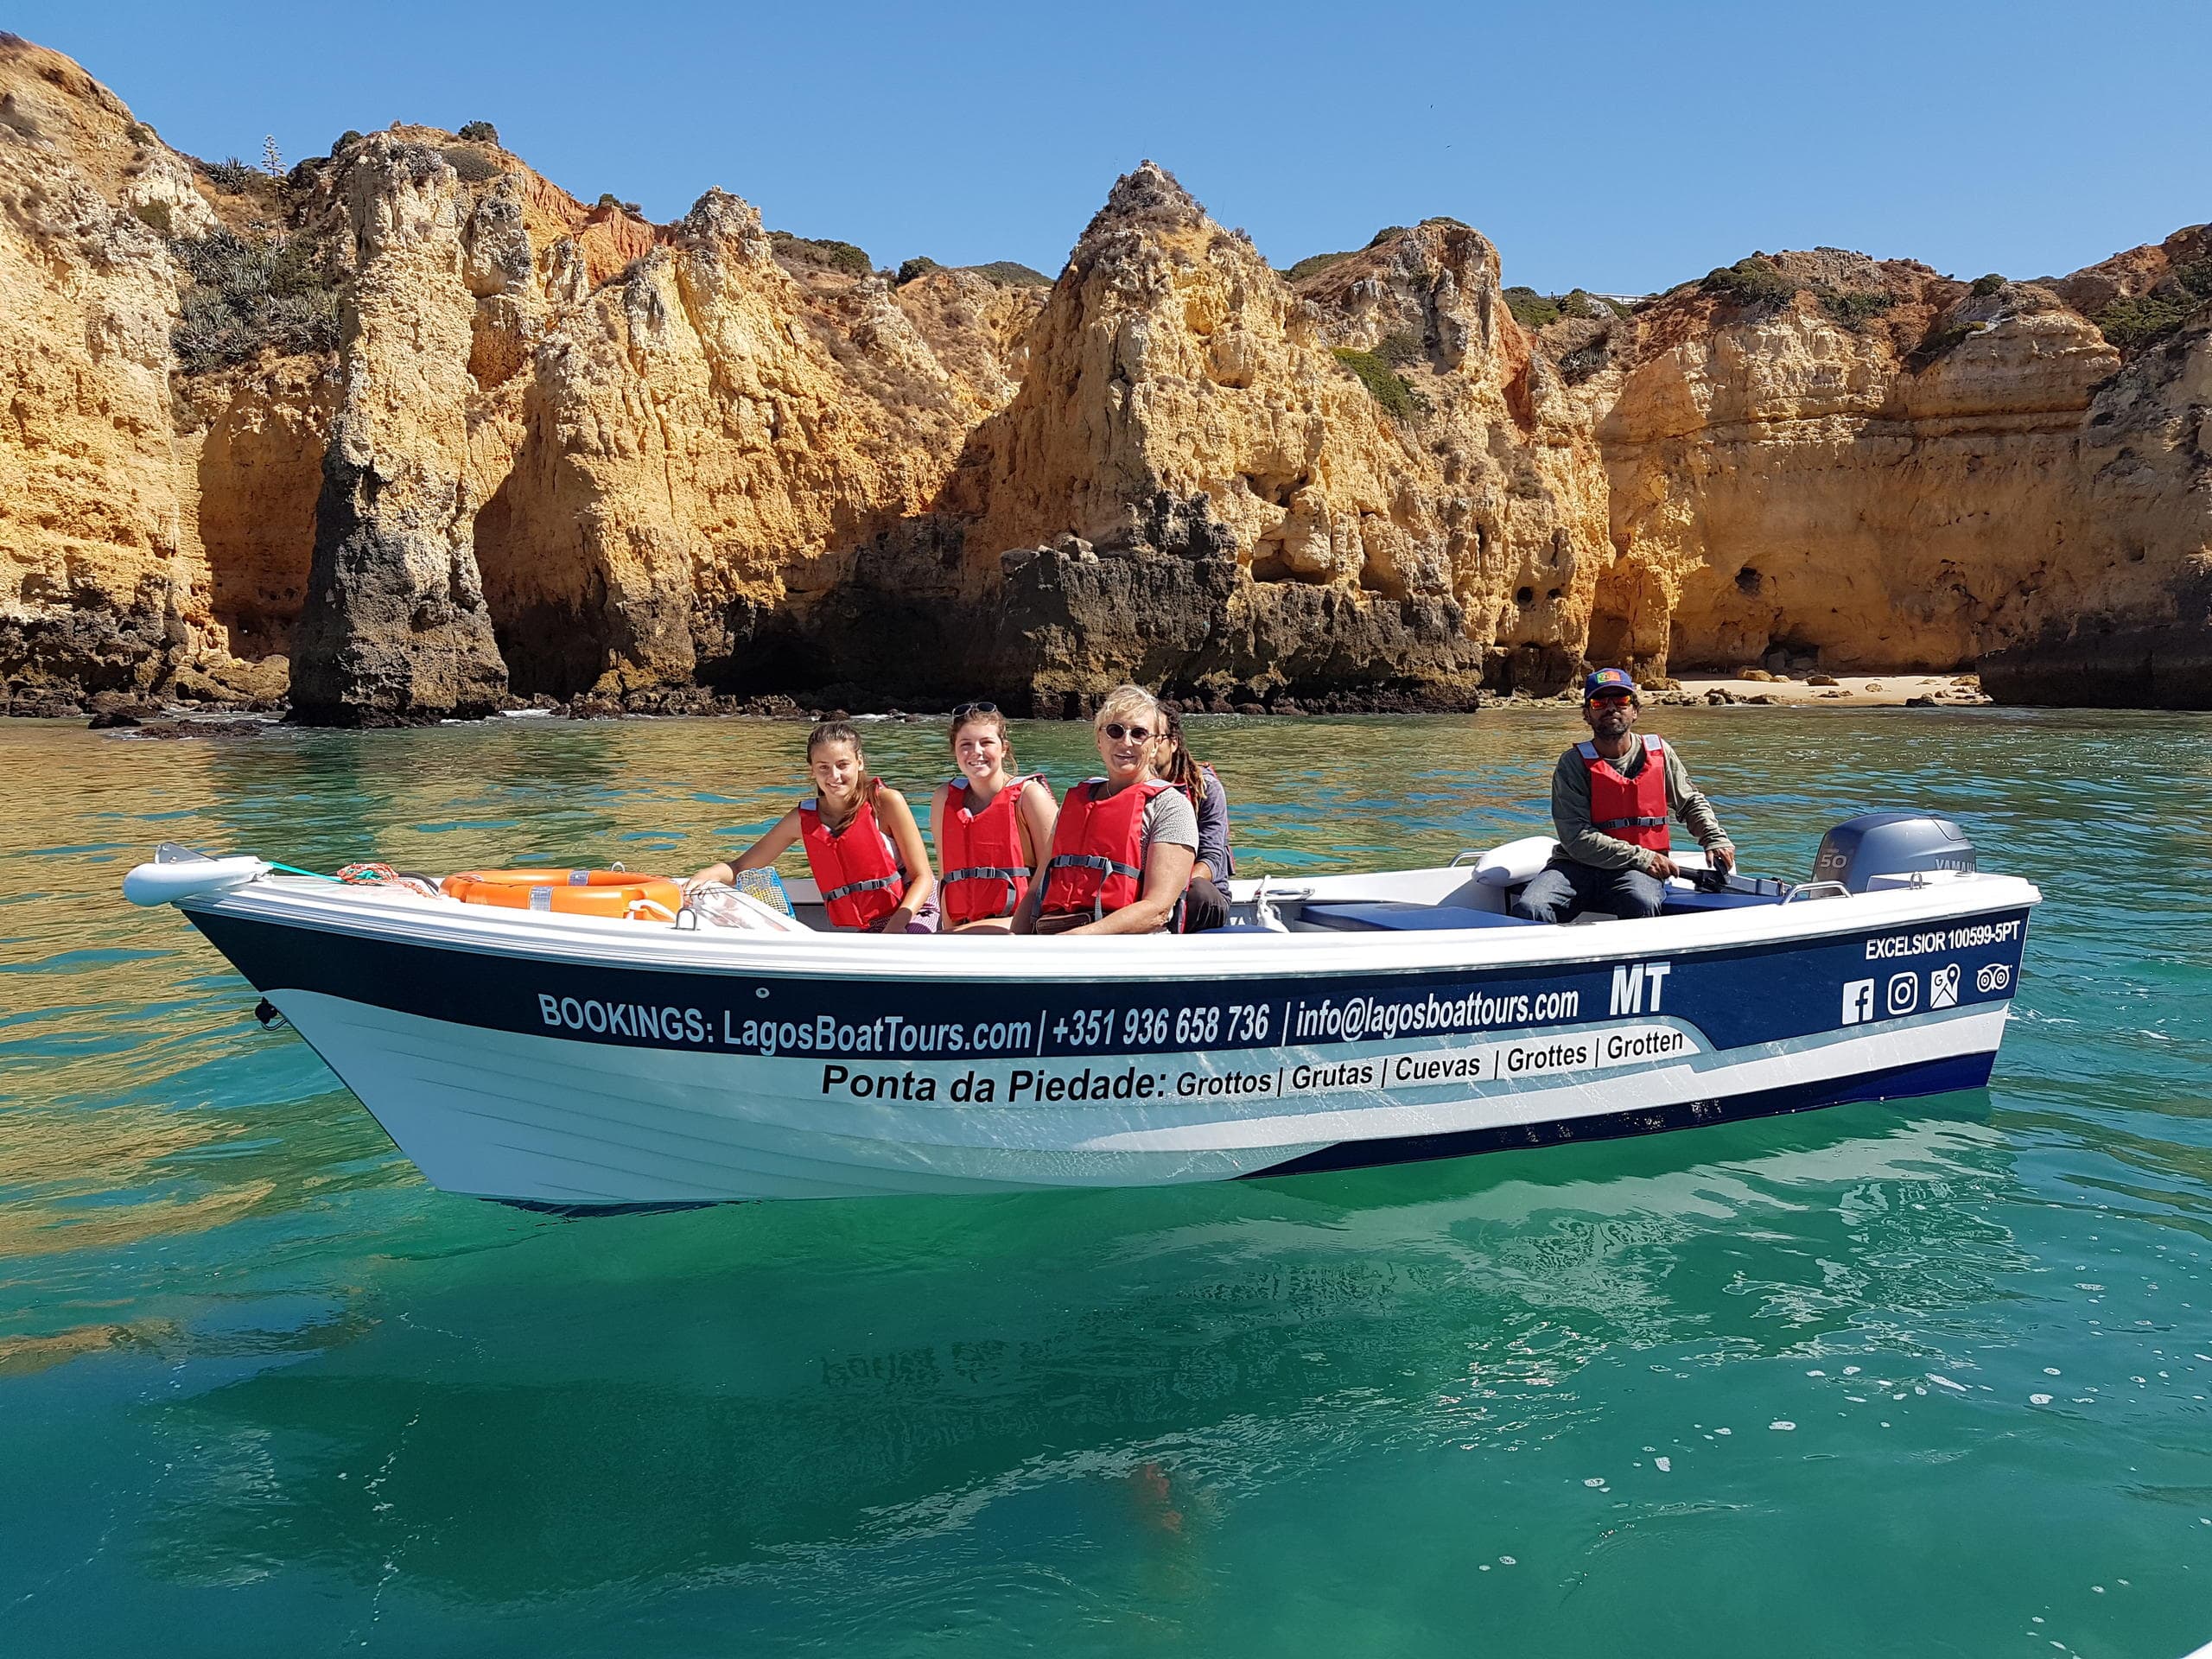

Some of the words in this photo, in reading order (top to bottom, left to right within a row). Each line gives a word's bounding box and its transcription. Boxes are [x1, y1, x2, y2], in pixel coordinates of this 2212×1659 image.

[1820, 854, 1847, 868] 50
[1865, 932, 1946, 960] EXCELSIOR
[1948, 920, 2021, 950] 100599-5PT
[1609, 961, 1671, 1016] MT
[537, 993, 715, 1044] BOOKINGS:
[724, 1009, 1032, 1057] LagosBoatTours.com
[1052, 1008, 1116, 1046] +351
[1122, 1007, 1169, 1045] 936
[1175, 1006, 1220, 1044] 658
[1226, 1003, 1270, 1041] 736
[1295, 989, 1579, 1042] info@lagosboattours.com
[822, 1064, 937, 1102] Ponta
[950, 1071, 995, 1103] da
[1007, 1066, 1166, 1103] Piedade:
[1176, 1071, 1272, 1097] Grottos
[1292, 1064, 1373, 1090] Grutas
[1395, 1056, 1480, 1081] Cuevas
[1507, 1044, 1587, 1072] Grottes
[1607, 1032, 1683, 1060] Grotten
